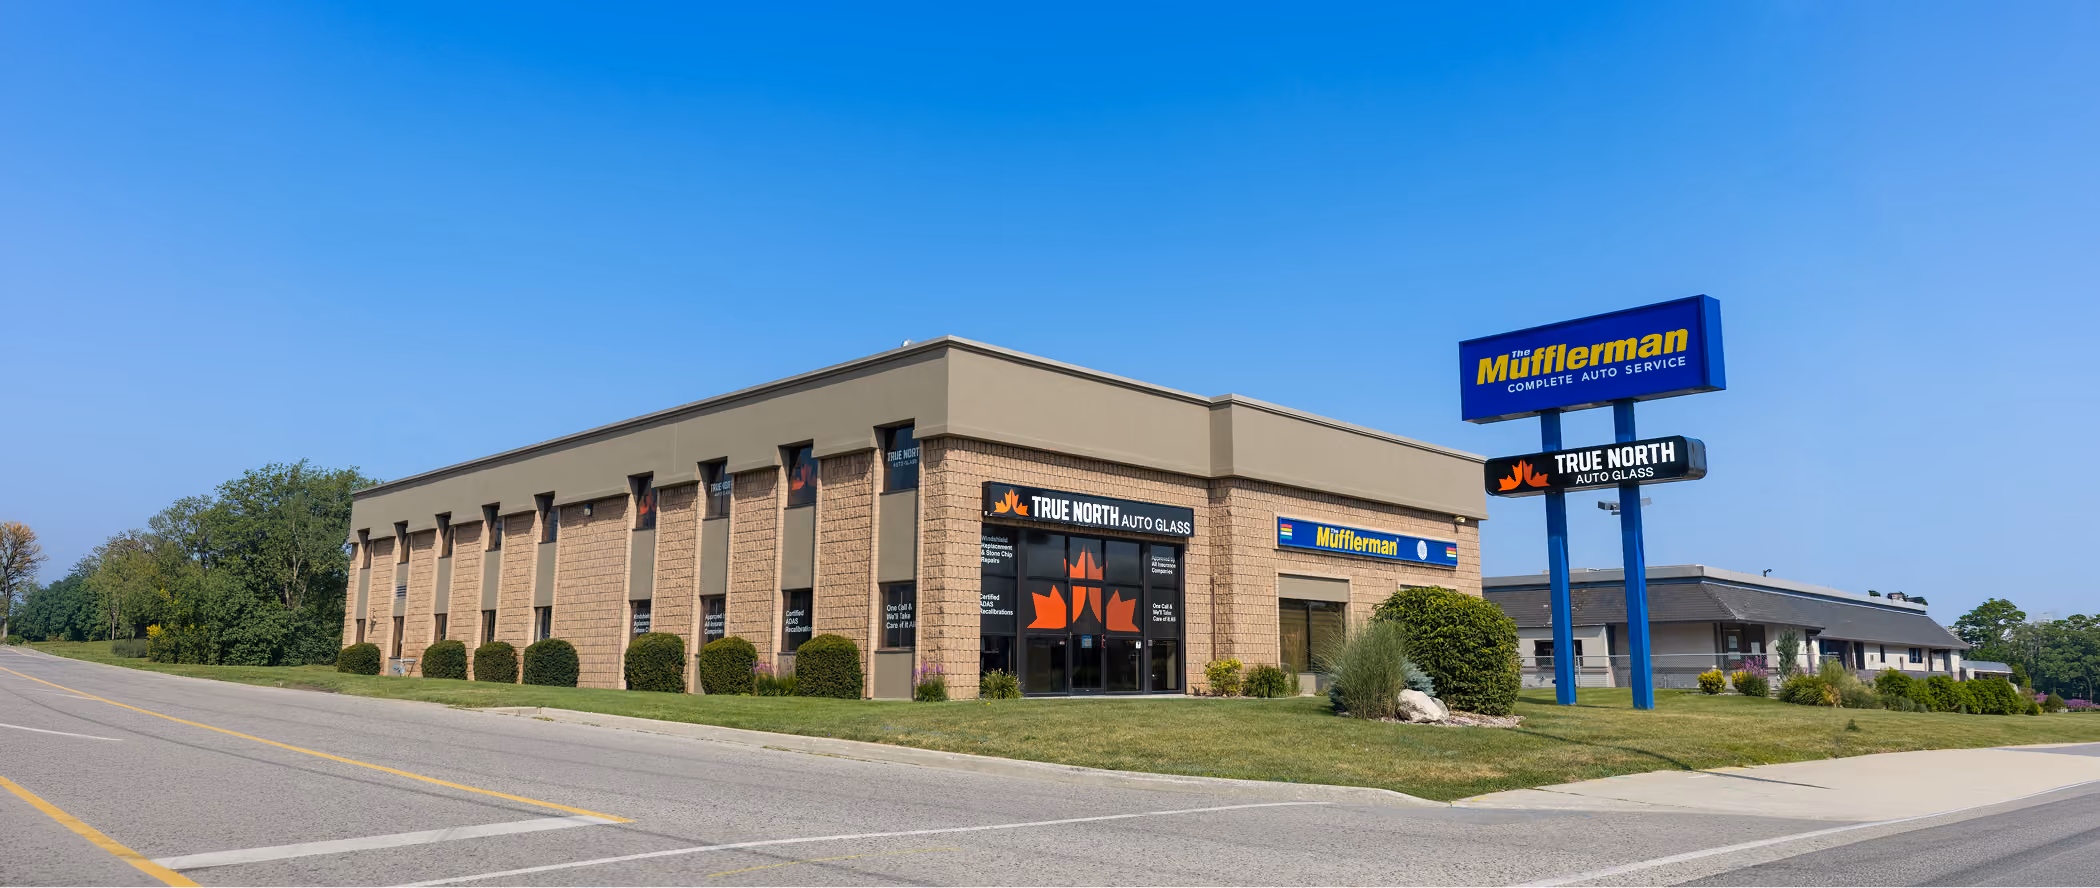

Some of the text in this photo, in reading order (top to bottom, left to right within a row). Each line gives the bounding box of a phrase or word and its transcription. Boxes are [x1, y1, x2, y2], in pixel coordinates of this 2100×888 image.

[1476, 328, 1689, 385] Mufflerman
[1512, 348, 1531, 358] The
[1507, 356, 1686, 393] COMPLETE AUTO SERVICE
[887, 450, 902, 462] TRUE
[1555, 441, 1676, 474] TRUE NORTH
[1575, 466, 1655, 484] AUTO GLASS
[1031, 495, 1191, 535] TRUE NORTH AUTO GLASS
[1316, 526, 1398, 556] Mufflerman
[1001, 551, 1013, 559] Chip
[887, 604, 897, 612] One
[898, 603, 908, 611] Call
[786, 617, 799, 625] ADAS
[886, 621, 898, 629] Care
